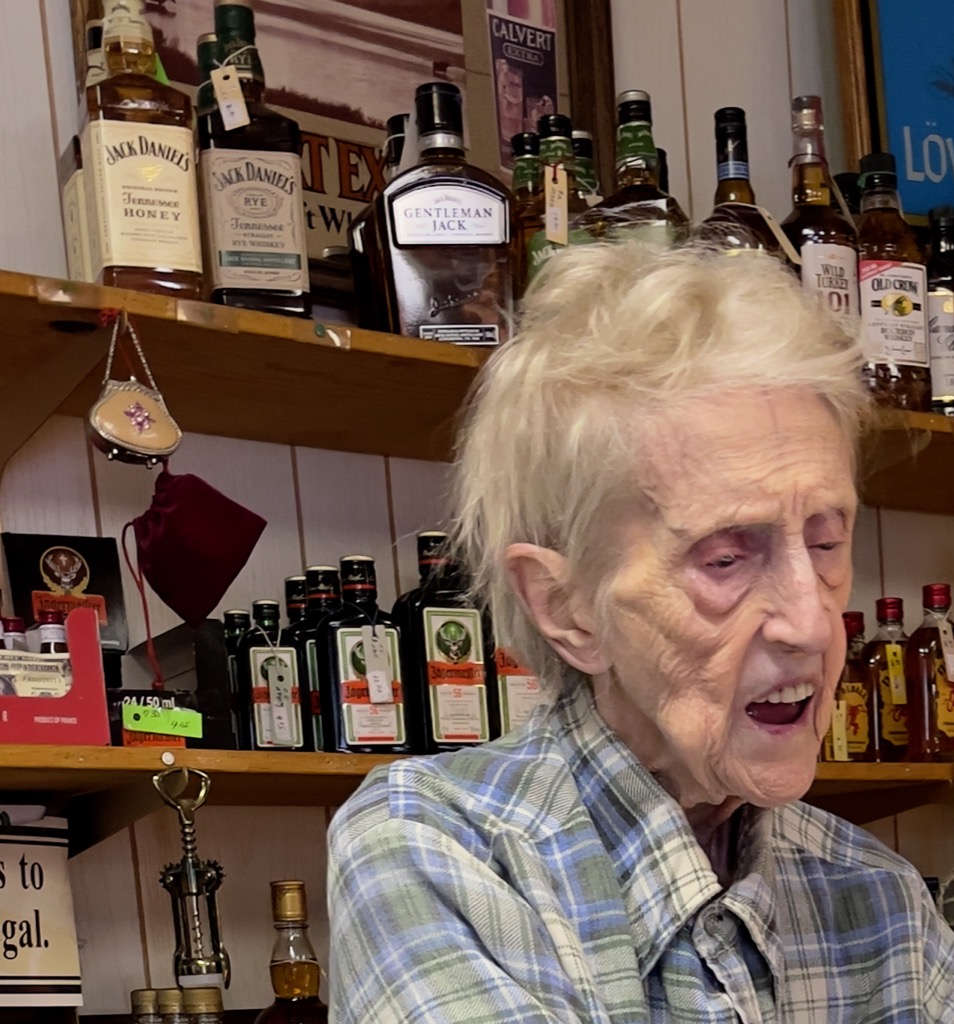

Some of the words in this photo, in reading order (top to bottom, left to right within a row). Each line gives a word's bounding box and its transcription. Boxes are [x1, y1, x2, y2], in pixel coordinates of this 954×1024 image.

[492, 18, 552, 50] CALVERT
[104, 140, 138, 165] JACK
[138, 135, 190, 172] DANIEL'S
[212, 167, 244, 192] JACK
[245, 161, 297, 195] DANIEL'S
[122, 192, 180, 208] Tennessee
[244, 197, 268, 207] RYE
[124, 207, 181, 221] HONEY
[404, 207, 493, 219] GENTLEMAN
[230, 217, 284, 231] Tennessee
[432, 219, 468, 232] JACK
[821, 264, 846, 278] WILD
[871, 278, 892, 291] OLD
[893, 278, 919, 295] CROW
[146, 696, 160, 708] 50
[162, 697, 176, 708] ml
[19, 853, 44, 890] to
[2, 909, 49, 960] gal.
